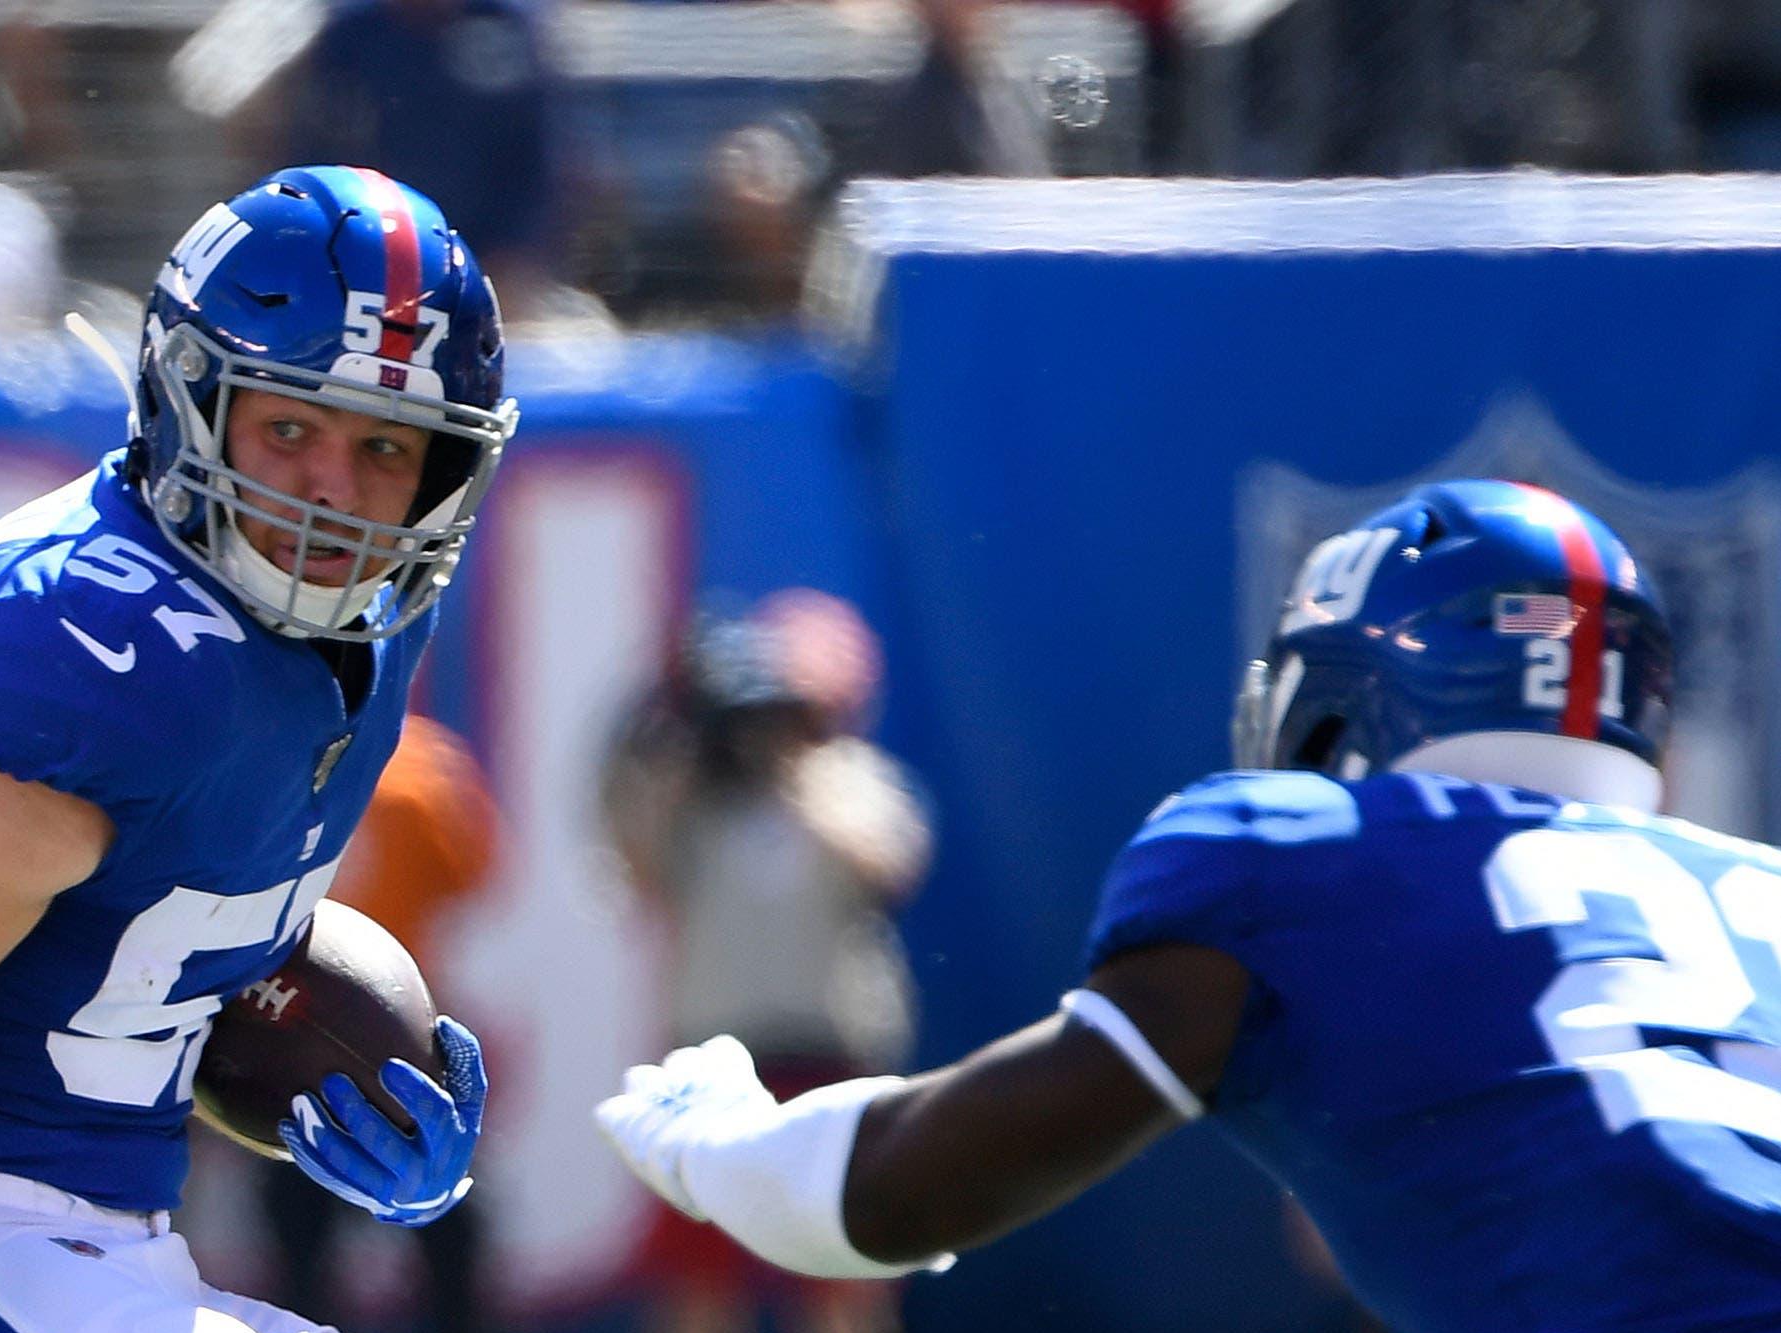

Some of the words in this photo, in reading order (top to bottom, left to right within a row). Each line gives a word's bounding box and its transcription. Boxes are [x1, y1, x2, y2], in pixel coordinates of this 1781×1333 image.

[341, 287, 450, 369] 57
[64, 533, 249, 653] 57
[1523, 637, 1624, 720] 21
